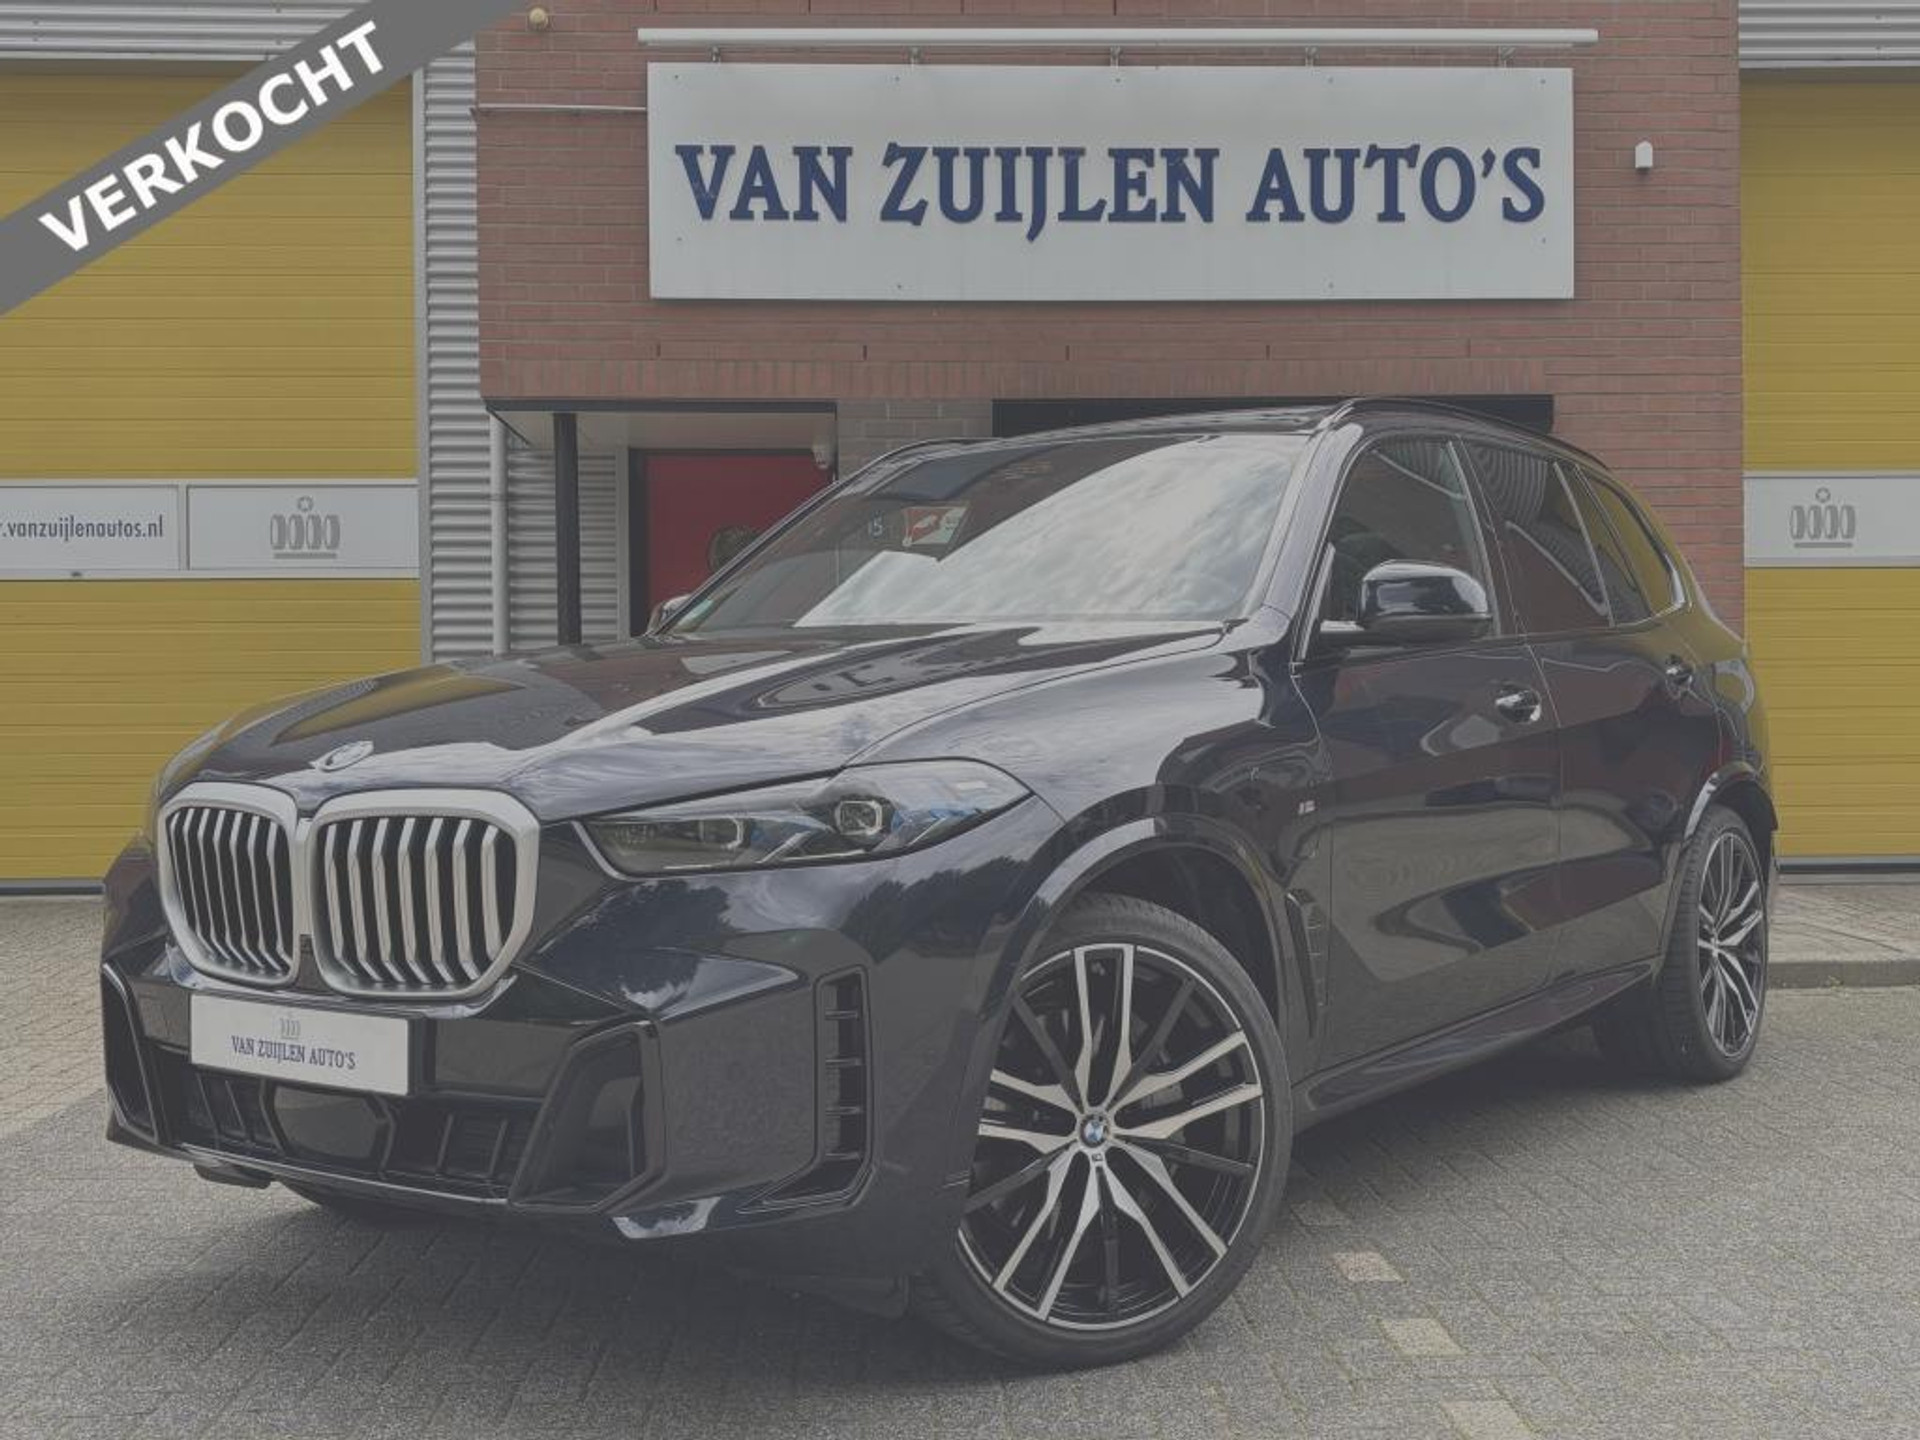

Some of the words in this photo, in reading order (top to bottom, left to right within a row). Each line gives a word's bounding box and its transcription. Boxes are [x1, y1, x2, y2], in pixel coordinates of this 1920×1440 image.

[675, 145, 853, 222] VAN
[880, 142, 1220, 242] ZUIJLEN
[1246, 144, 1546, 224] AUTO'S
[0, 514, 163, 541] .vanzuijlenautos.nl
[231, 1035, 255, 1056] VAN
[257, 1040, 305, 1064] ZUIJLEN
[309, 1047, 356, 1070] AUTO'S
